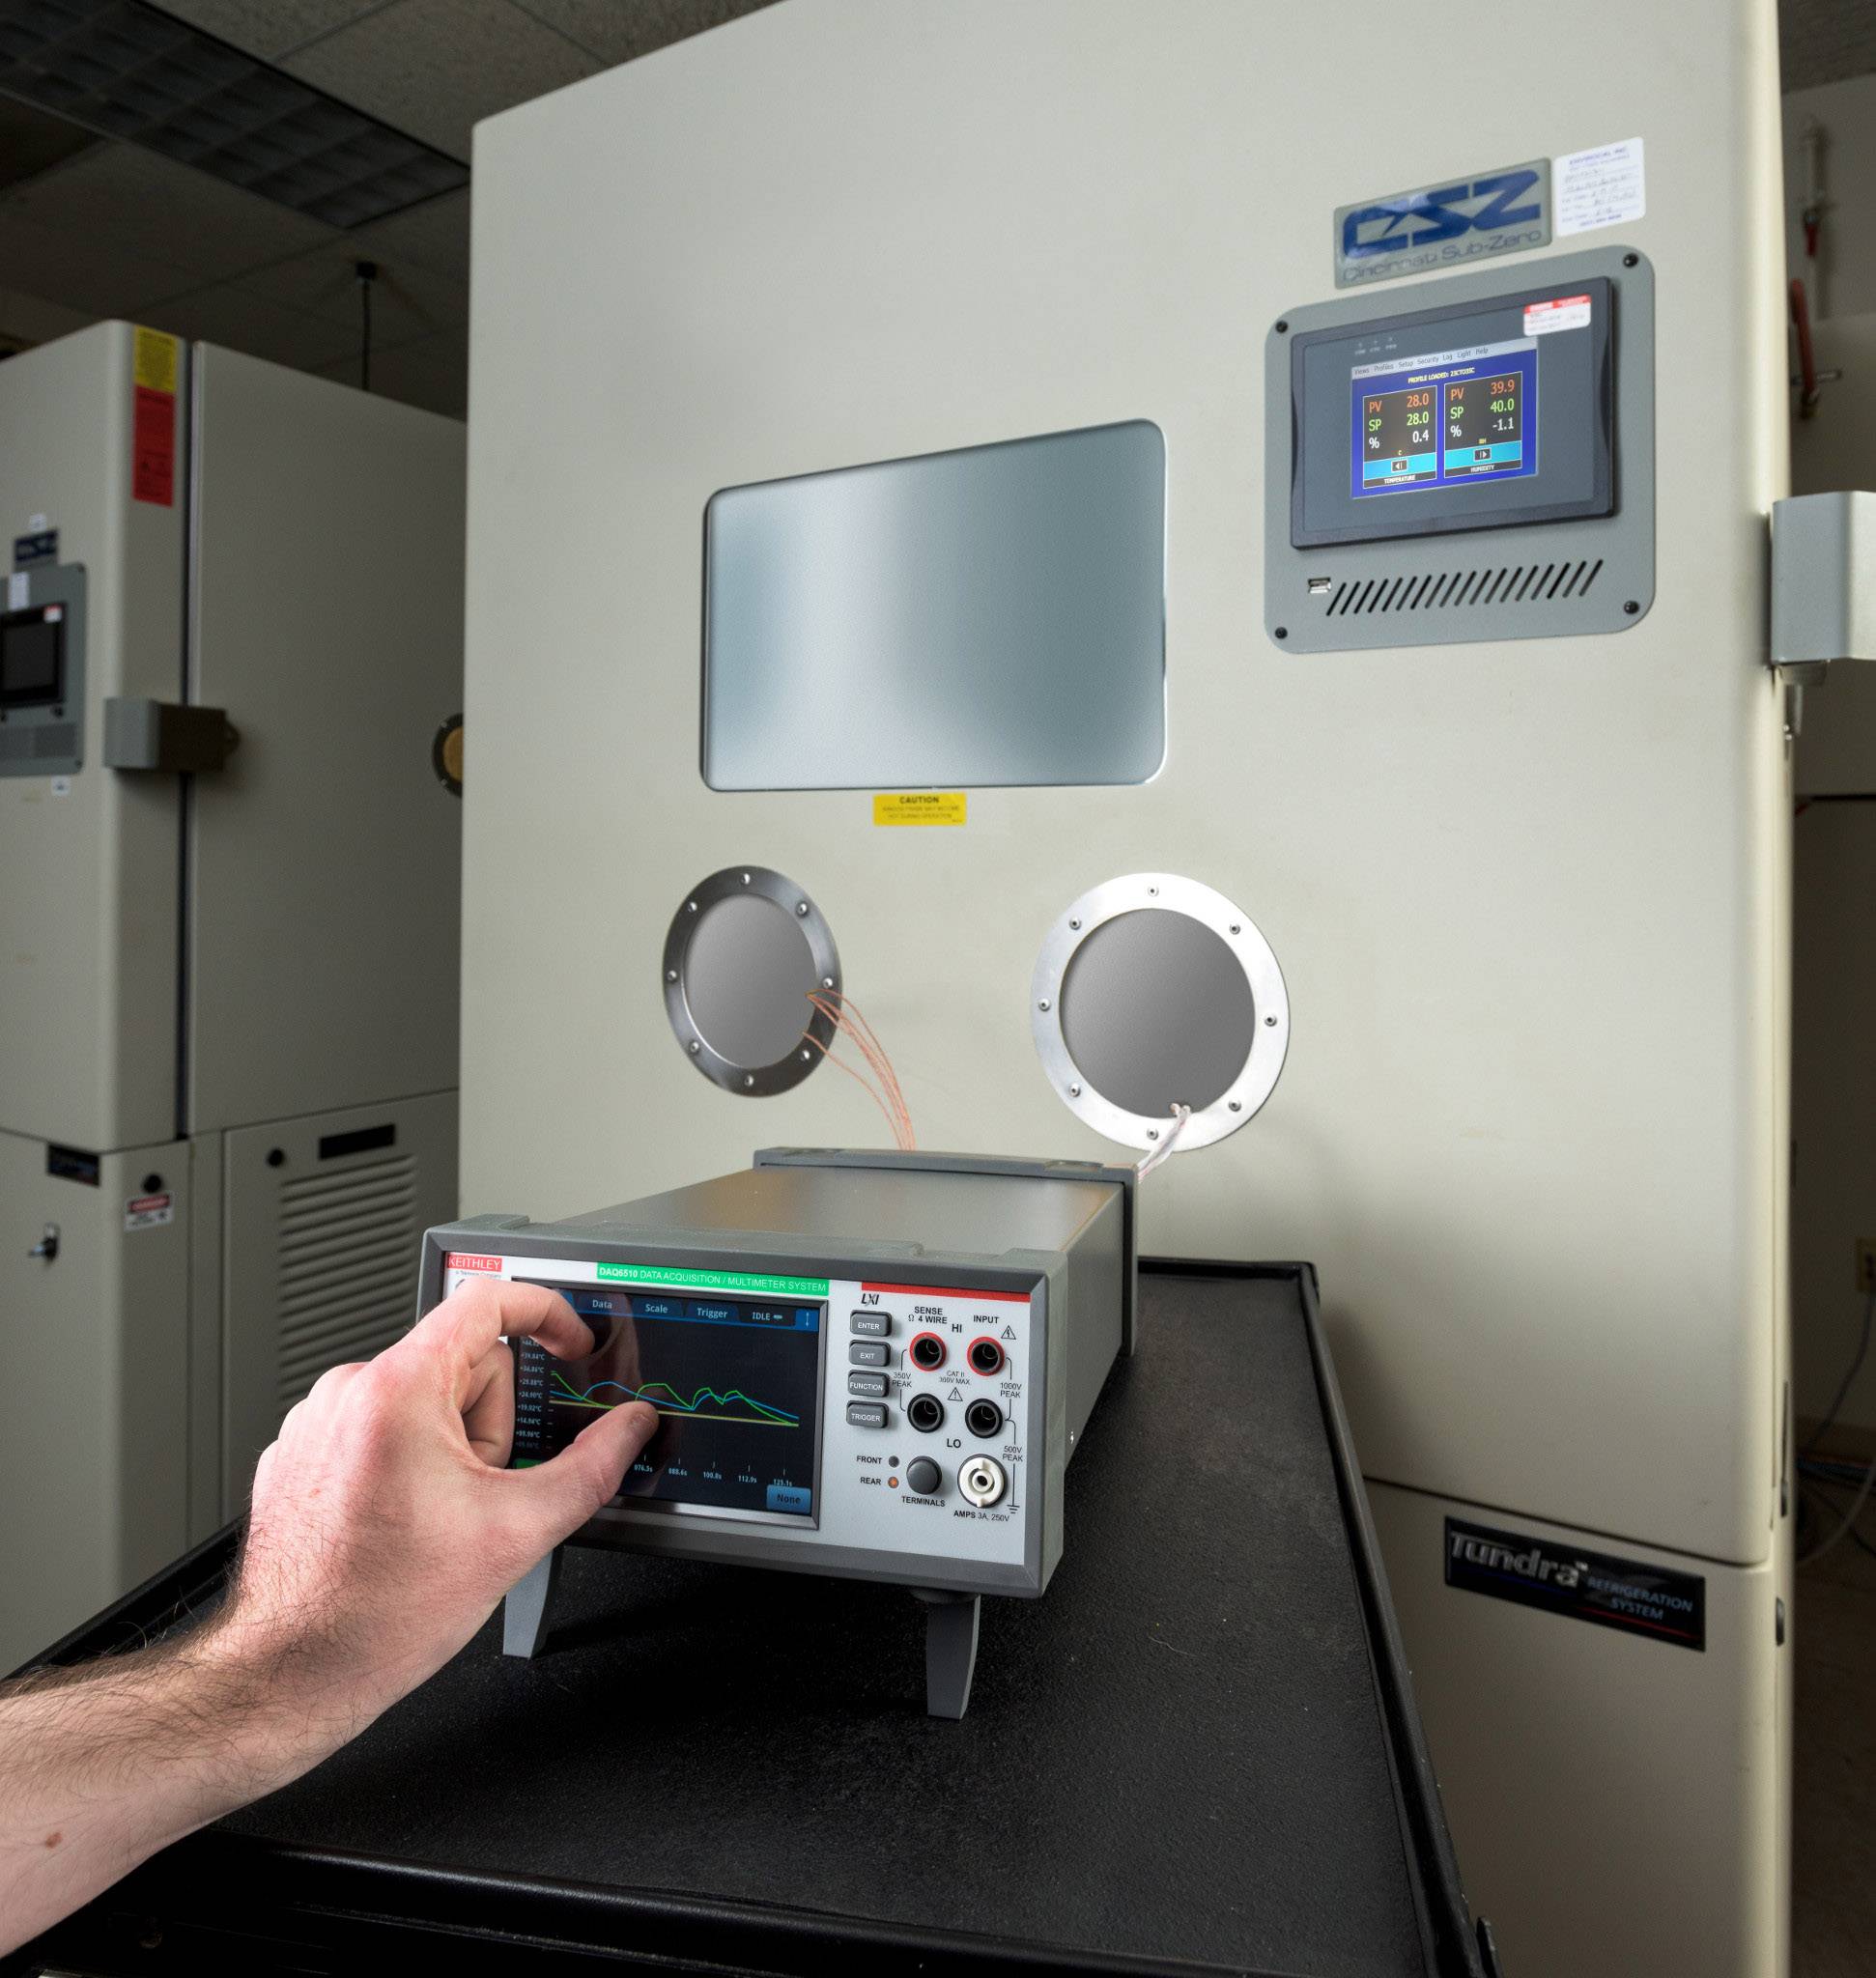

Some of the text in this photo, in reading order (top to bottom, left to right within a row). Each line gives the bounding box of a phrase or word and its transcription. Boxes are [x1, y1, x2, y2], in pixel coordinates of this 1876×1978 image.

[1441, 230, 1543, 260] Sub-Zero
[1416, 355, 1439, 366] Security
[1451, 379, 1516, 401] PV 39.9
[1369, 393, 1430, 413] PV 28.0
[1450, 398, 1515, 420] SP 40.0
[1369, 410, 1430, 432] SP 28.0
[1450, 417, 1515, 438] % -1.1
[1369, 429, 1430, 449] % 0.4
[1470, 464, 1495, 473] HUMIDITY
[1383, 474, 1416, 484] TEMPERATURE
[448, 1257, 501, 1270] KEITHLEY
[599, 1266, 639, 1278] DAQ6510
[640, 1270, 663, 1280] DATA
[663, 1271, 722, 1285] ACQUISITION
[727, 1276, 786, 1289] MULTIMETER
[787, 1281, 827, 1292] SYSTEM
[592, 1299, 771, 1321] Data Scale Trigger IDLE
[914, 1306, 943, 1315] SENSE
[924, 1315, 948, 1324] WIRE
[973, 1314, 1000, 1324] INPUT
[858, 1321, 880, 1330] ENTER
[952, 1323, 963, 1333] HI
[893, 1371, 911, 1380] 350V
[850, 1381, 883, 1391] FUNCTION
[892, 1379, 913, 1388] PEAK
[1000, 1390, 1021, 1399] PEAK
[851, 1413, 881, 1423] TRIGGER
[947, 1438, 961, 1449] LO
[1004, 1445, 1022, 1454] 500V
[856, 1455, 882, 1464] FRONT
[1002, 1454, 1023, 1462] PEAK
[860, 1476, 882, 1485] REAR
[777, 1493, 802, 1505] None
[901, 1495, 946, 1508] TERMINALS
[953, 1510, 976, 1519] AMPS
[991, 1513, 1010, 1522] 250V
[1451, 1531, 1580, 1589] Tundra
[1587, 1576, 1693, 1612] REFRIGERATION
[1611, 1597, 1663, 1621] SYSTEM
